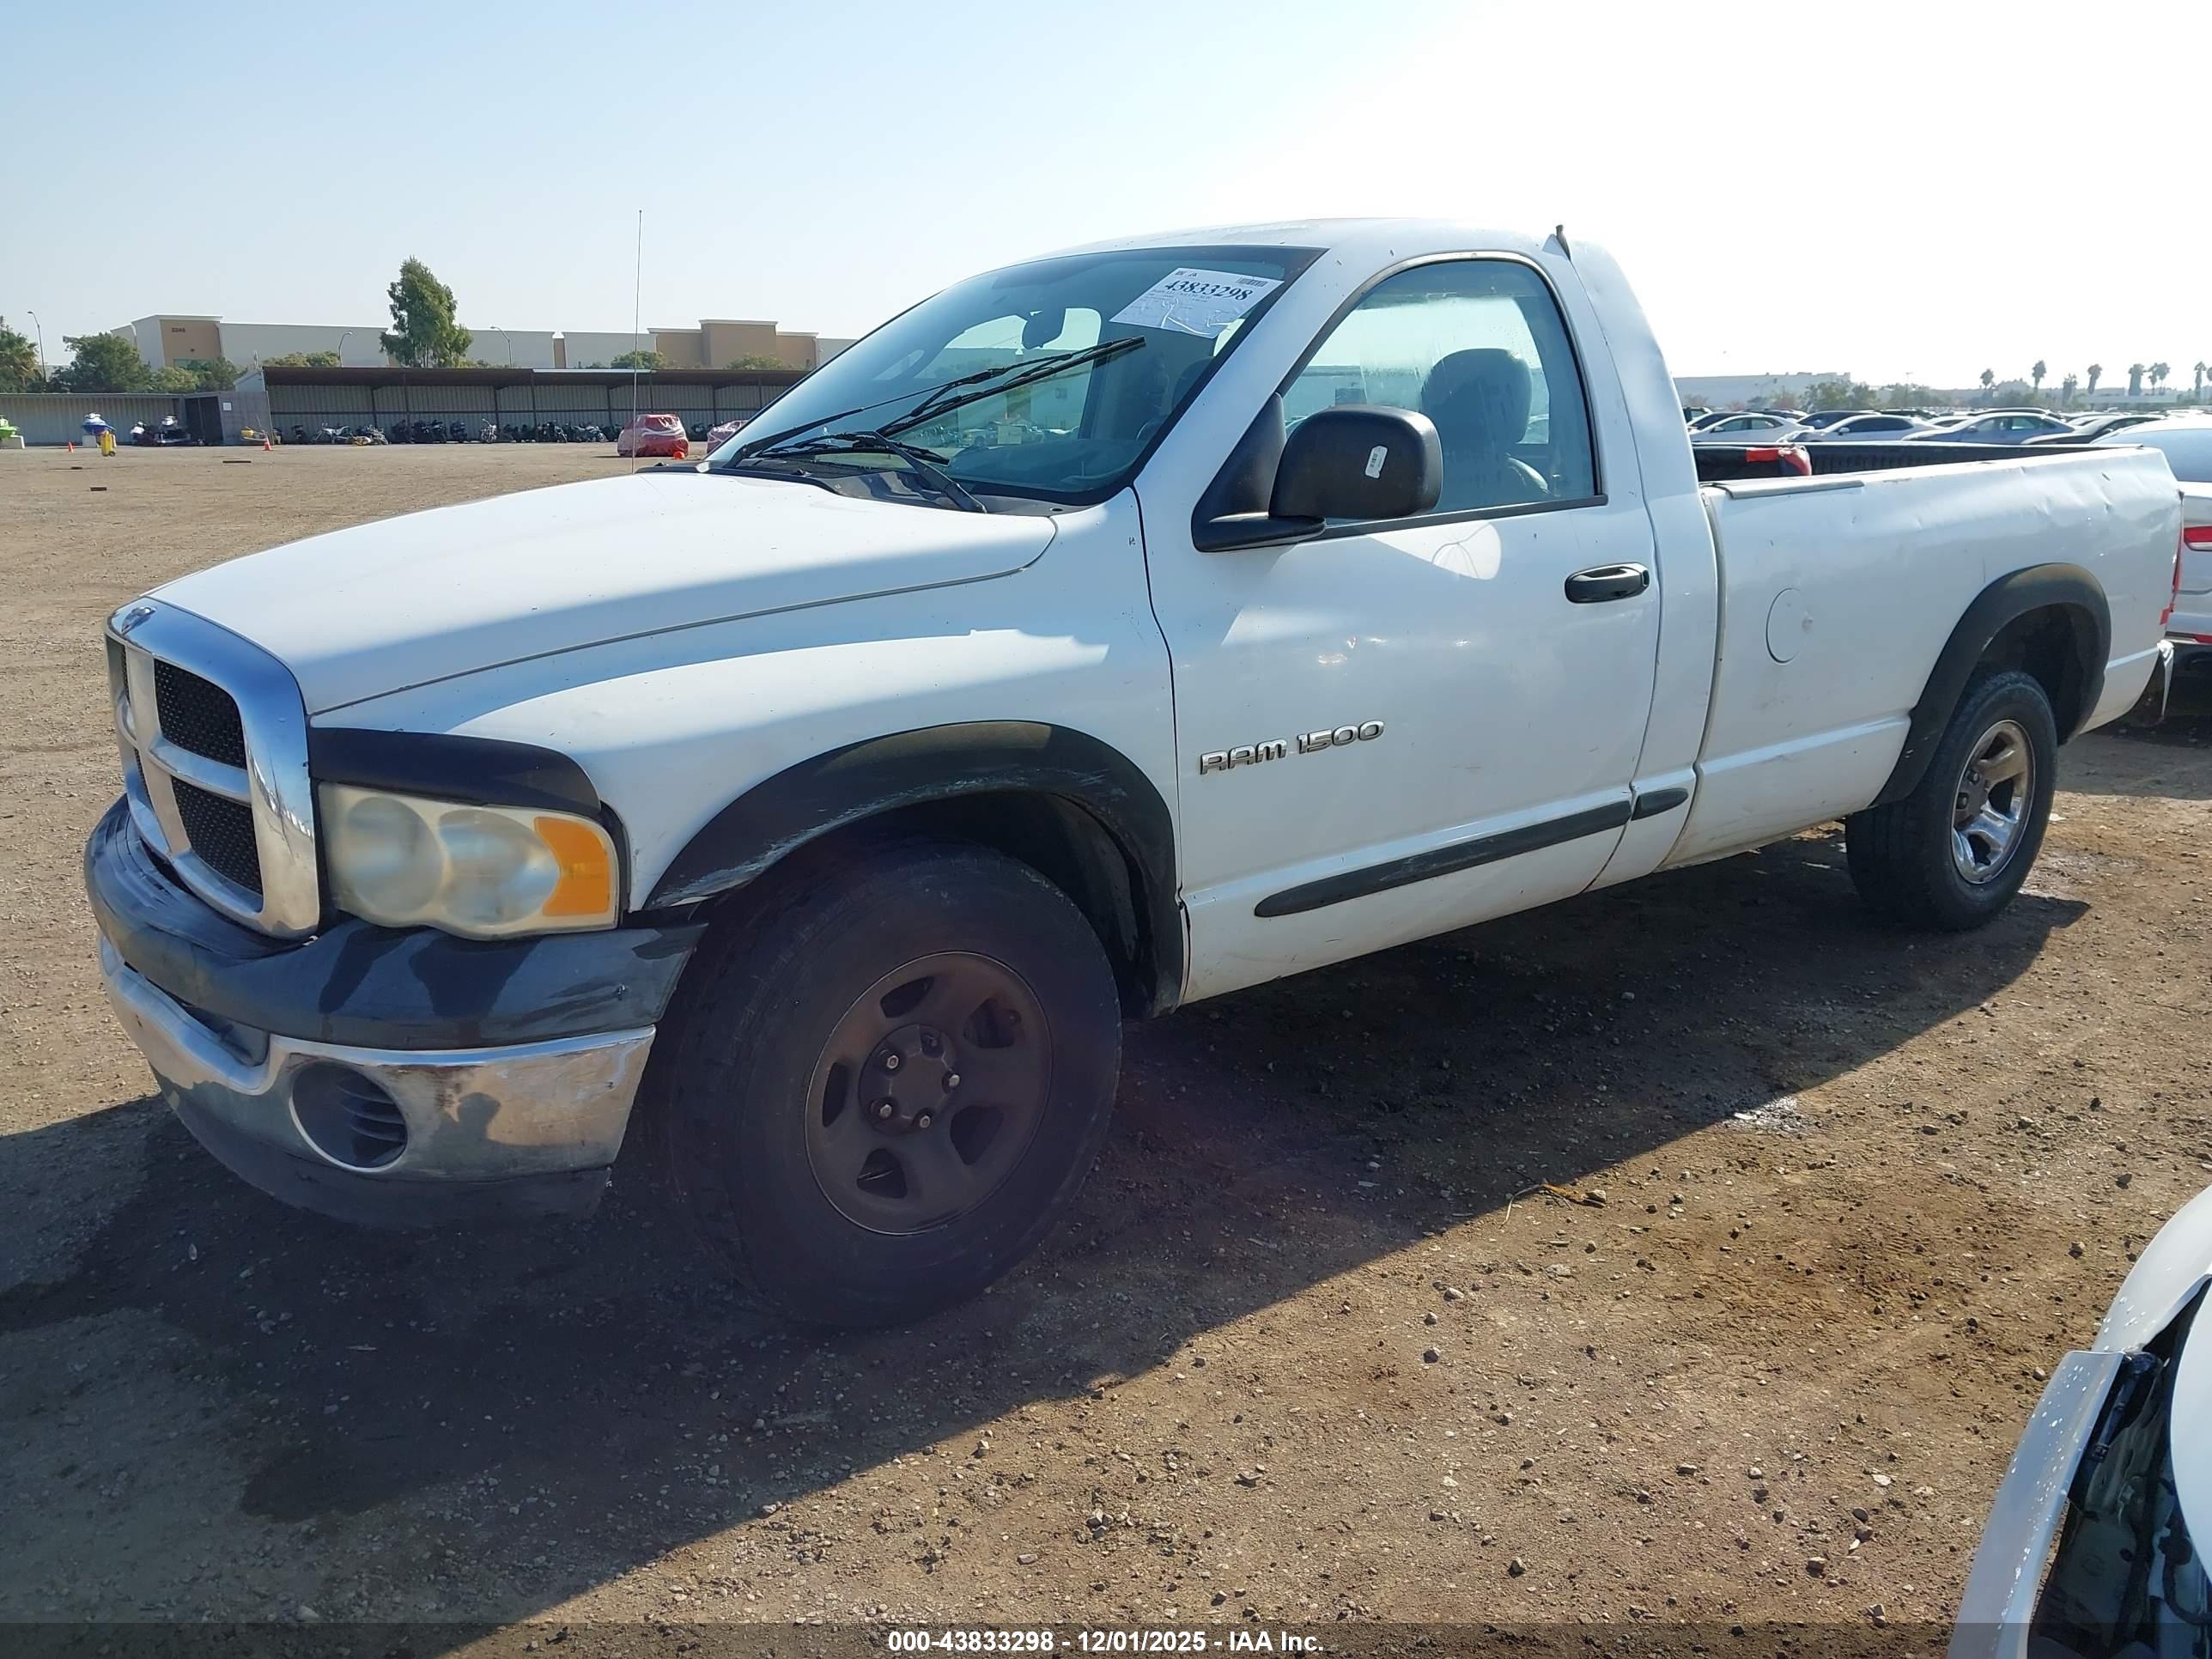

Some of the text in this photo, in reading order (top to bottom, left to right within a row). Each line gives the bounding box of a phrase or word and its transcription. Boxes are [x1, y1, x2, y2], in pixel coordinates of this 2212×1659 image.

[1165, 280, 1254, 301] 43833298
[1200, 719, 1385, 775] RAM 1500
